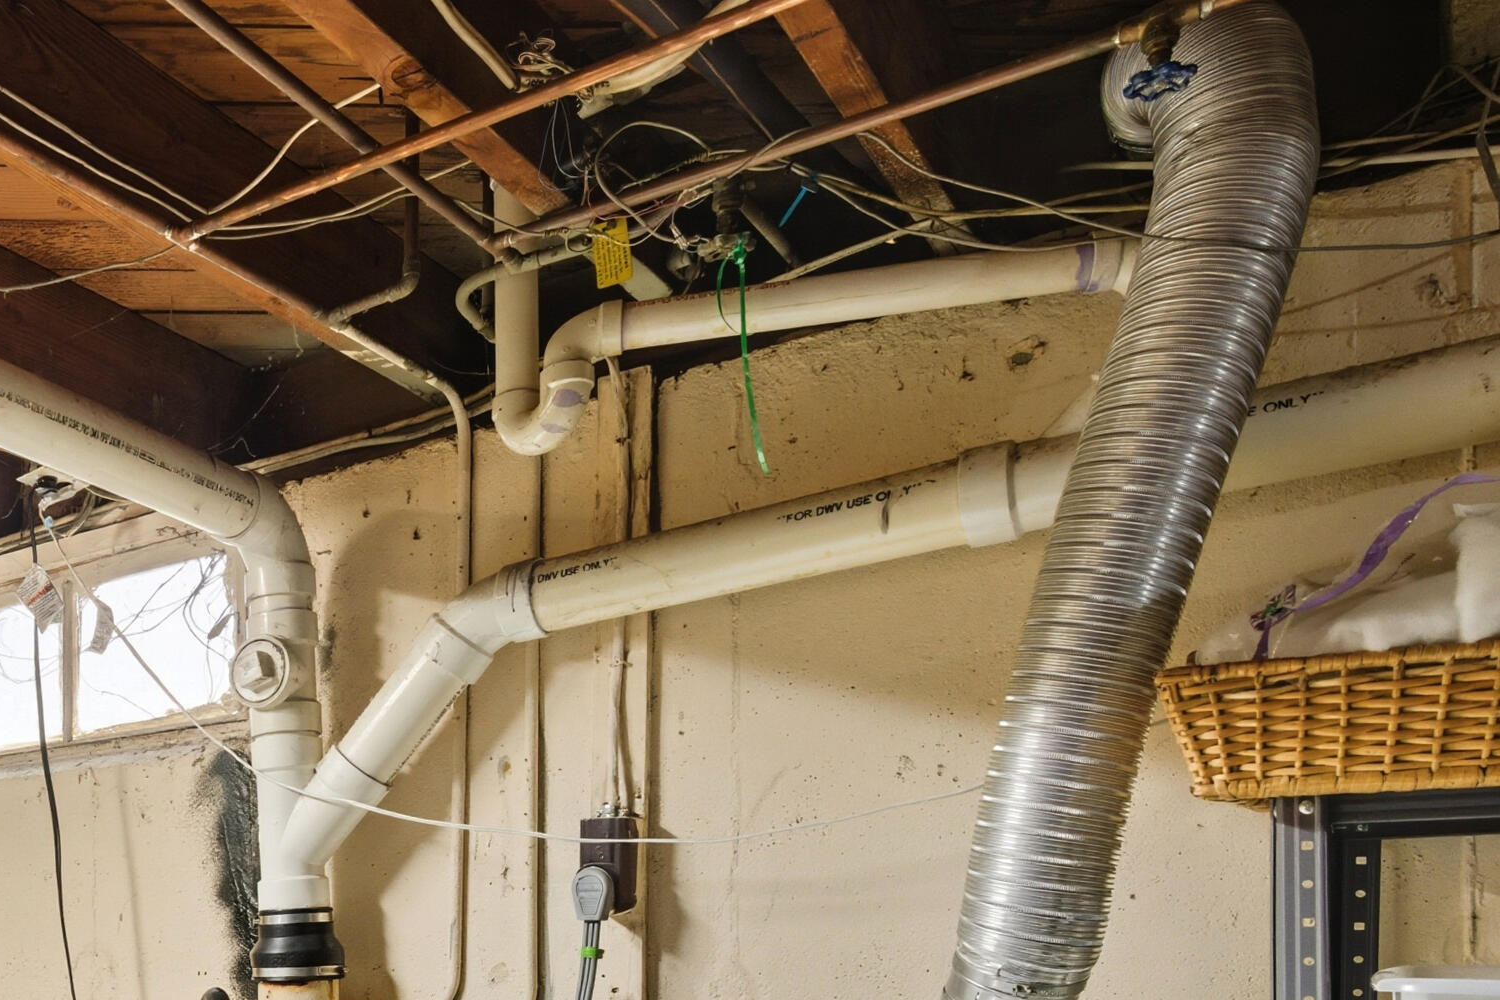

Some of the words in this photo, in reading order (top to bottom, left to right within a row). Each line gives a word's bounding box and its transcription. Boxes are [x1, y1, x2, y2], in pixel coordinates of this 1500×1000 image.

[816, 501, 843, 517] DWV
[846, 494, 873, 509] USE
[537, 570, 559, 584] DWV
[560, 565, 580, 578] USE
